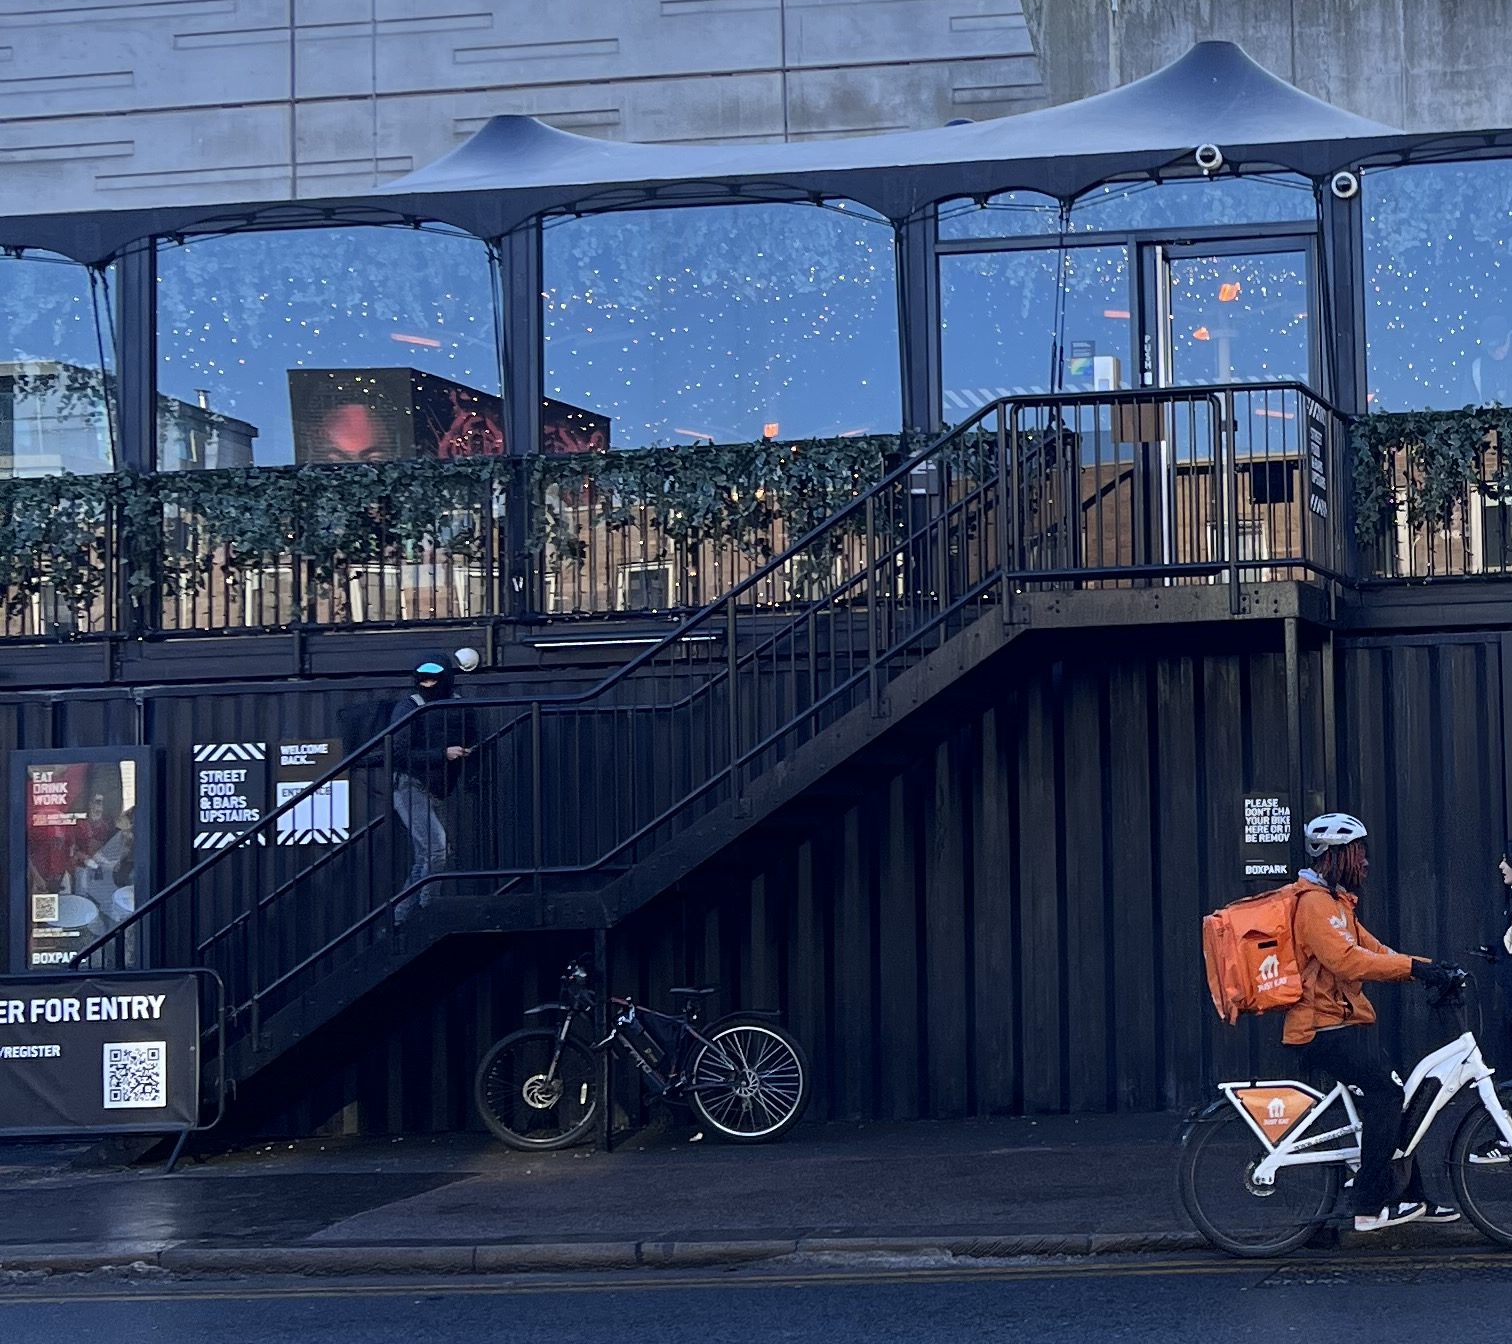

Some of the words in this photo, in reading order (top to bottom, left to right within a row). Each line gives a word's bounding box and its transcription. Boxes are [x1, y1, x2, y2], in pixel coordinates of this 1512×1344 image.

[280, 743, 329, 755] WELCOME
[32, 771, 54, 783] EAT
[200, 769, 247, 783] STREET
[32, 782, 68, 794] DRINK
[200, 783, 235, 796] FOOD
[32, 794, 67, 805] WORK
[200, 798, 212, 809] &
[212, 796, 247, 809] BARS
[1244, 798, 1279, 808] PLEASE
[200, 809, 260, 823] UPSTAIRS
[1244, 808, 1271, 817] DON'T
[1272, 807, 1290, 816] CHA
[1245, 817, 1270, 825] YOUR
[1245, 825, 1269, 834] HERE
[1245, 834, 1258, 843] BE
[1259, 833, 1290, 843] REMOV
[1245, 864, 1288, 875] BOXPARK
[30, 998, 81, 1023] FOR
[86, 995, 166, 1021] ENTRY
